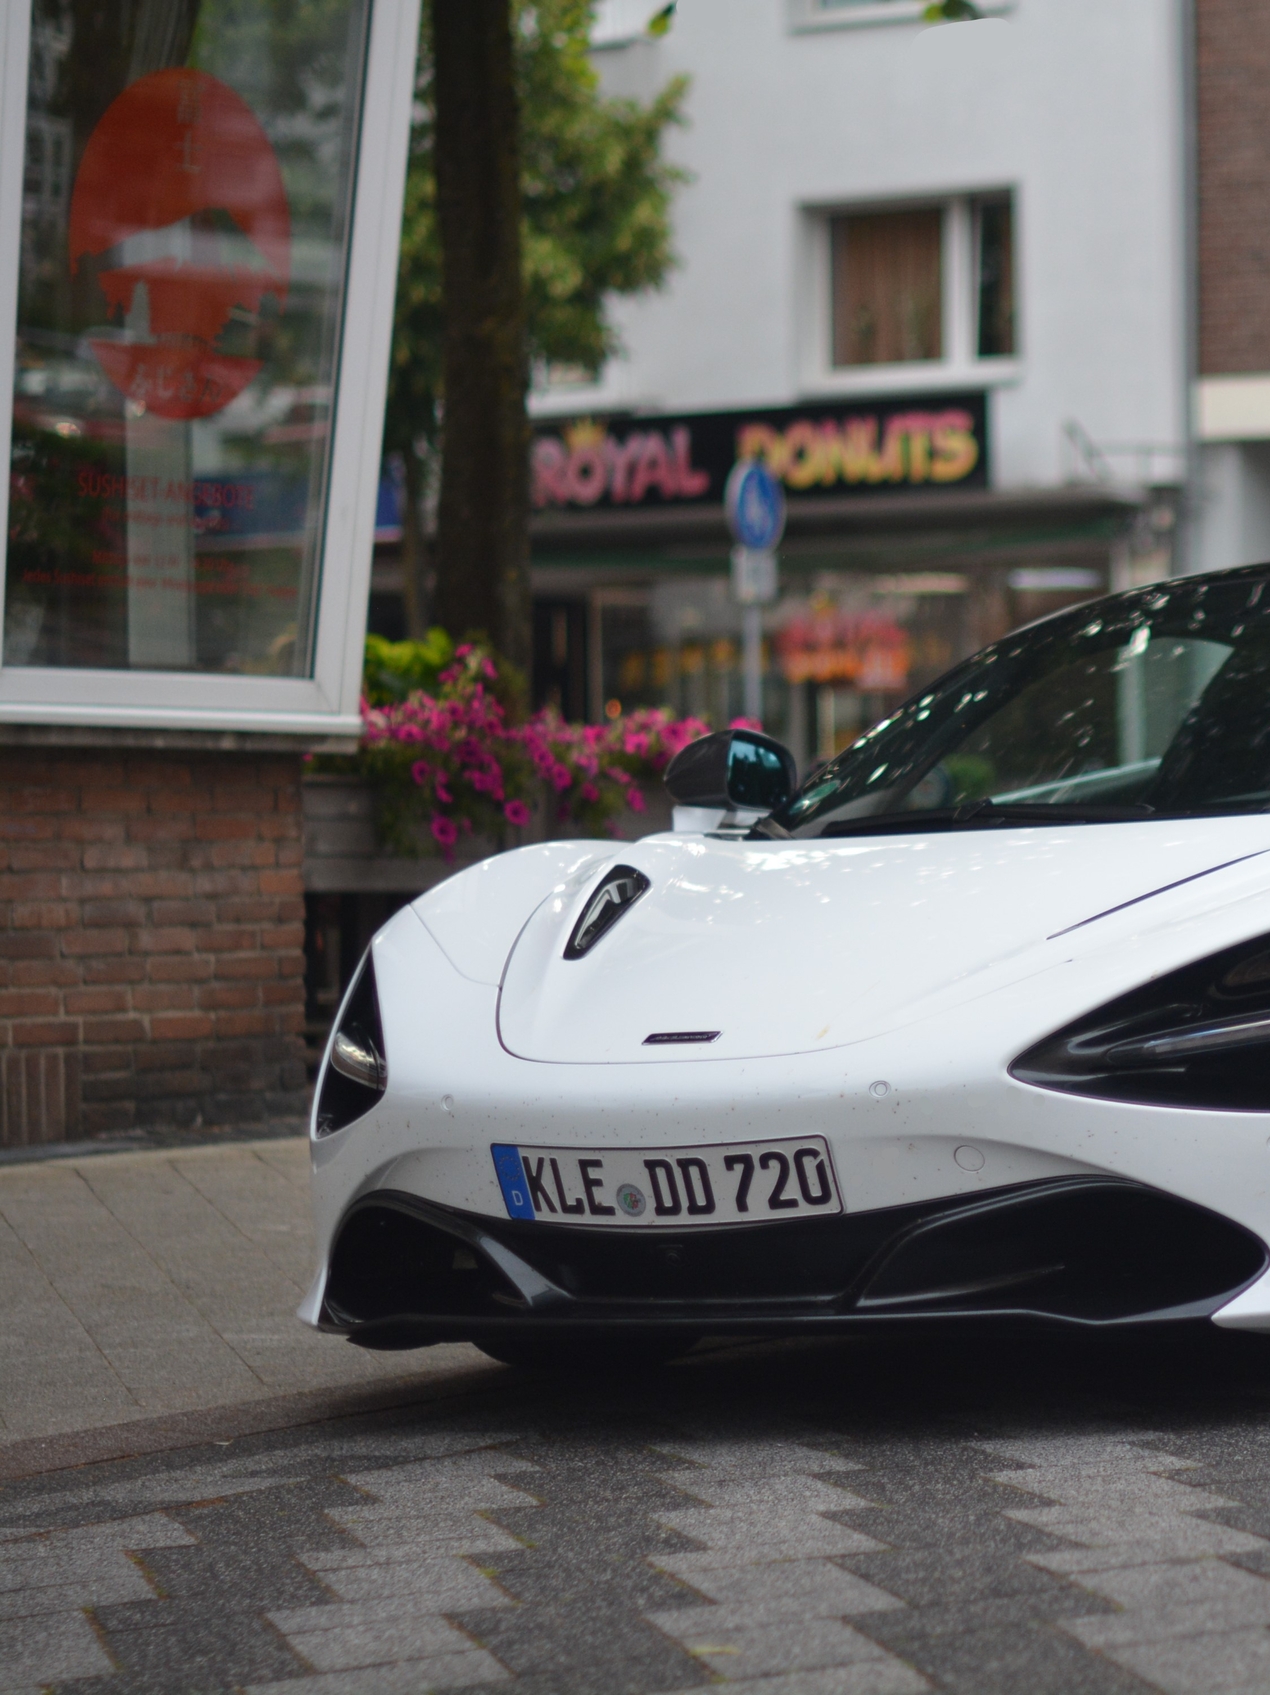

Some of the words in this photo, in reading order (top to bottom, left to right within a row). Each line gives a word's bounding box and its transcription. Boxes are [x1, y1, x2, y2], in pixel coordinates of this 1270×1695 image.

[530, 424, 711, 507] ROYAL
[735, 408, 979, 488] DONUTS
[511, 1189, 524, 1207] D
[521, 1155, 616, 1216] KLE
[643, 1156, 716, 1217] DD
[723, 1146, 833, 1213] 720
